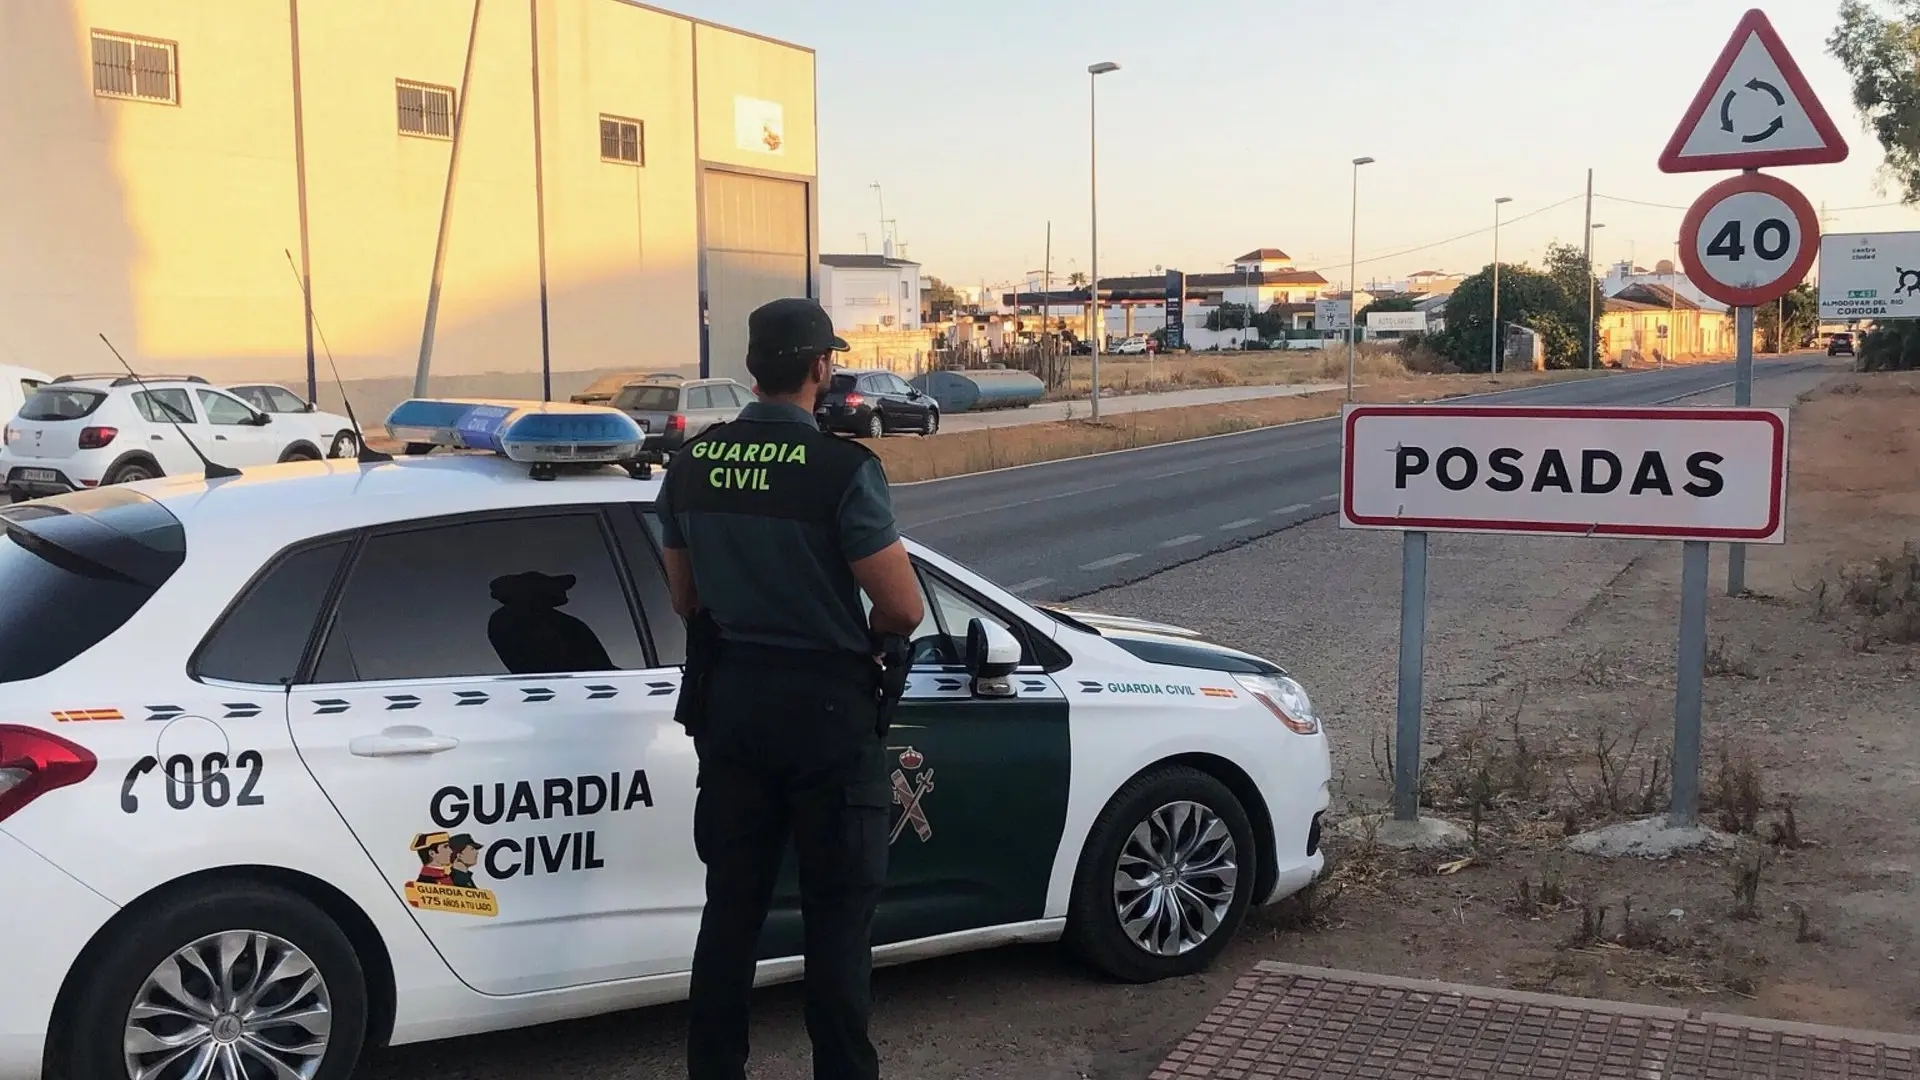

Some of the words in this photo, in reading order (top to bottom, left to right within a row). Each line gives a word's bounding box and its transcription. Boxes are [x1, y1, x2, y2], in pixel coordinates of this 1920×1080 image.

[1706, 218, 1790, 261] 40
[1837, 307, 1887, 315] CORDOBA
[691, 441, 806, 464] GUARDIA
[709, 467, 770, 490] CIVIL
[1395, 446, 1724, 498] POSADAS
[1107, 683, 1163, 695] GUARDIA
[1166, 686, 1195, 696] CIVIL
[165, 749, 264, 810] 062
[430, 769, 654, 829] GUARDIA
[484, 831, 604, 880] CIVIL
[417, 885, 463, 897] GUARDIA
[465, 890, 490, 900] CIVIL
[420, 895, 441, 905] 175
[461, 901, 465, 909] A
[466, 901, 475, 910] TU
[475, 902, 492, 911] LADO
